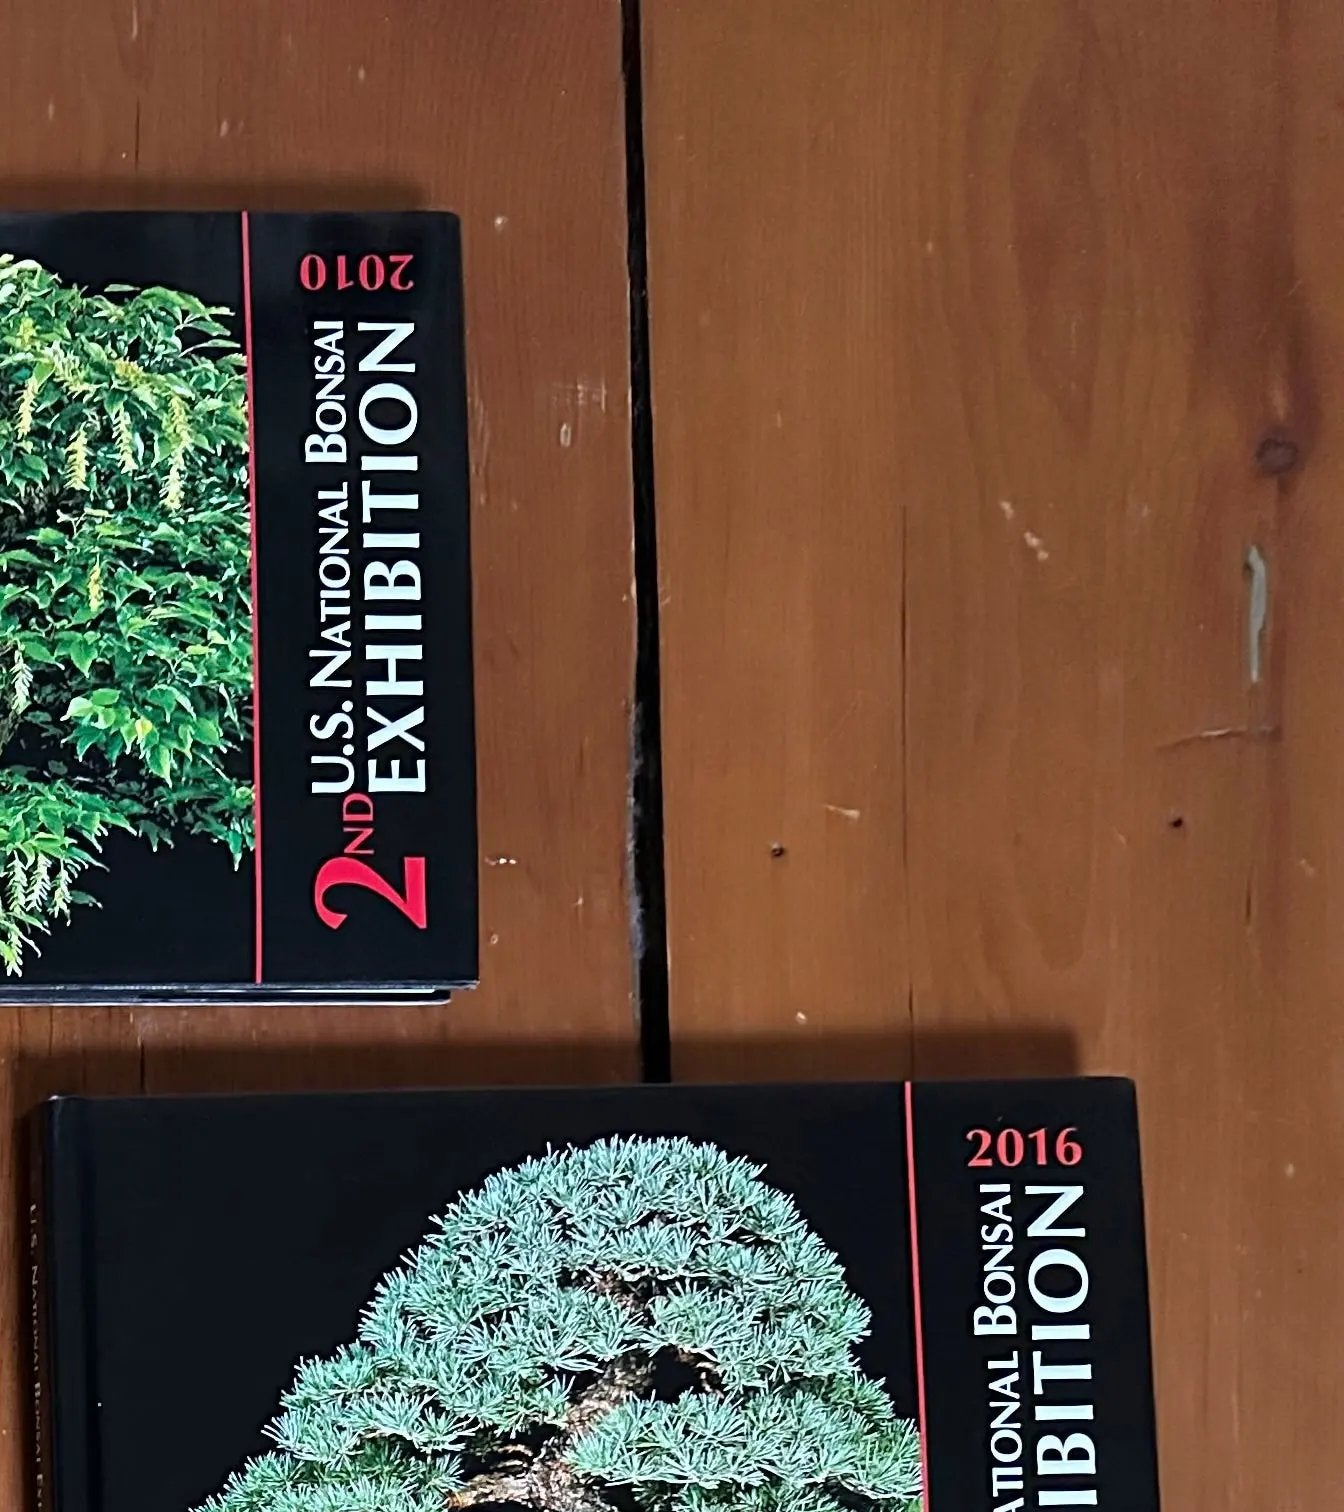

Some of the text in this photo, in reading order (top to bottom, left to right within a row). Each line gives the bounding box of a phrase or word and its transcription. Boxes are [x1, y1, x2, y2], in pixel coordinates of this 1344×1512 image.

[300, 254, 413, 291] 2010
[304, 320, 427, 930] 2ND U.S. NATIONAL BONSAI
[357, 321, 426, 793] EXHIBITION
[966, 1128, 1083, 1167] 2016
[973, 1183, 1019, 1336] BONSAI
